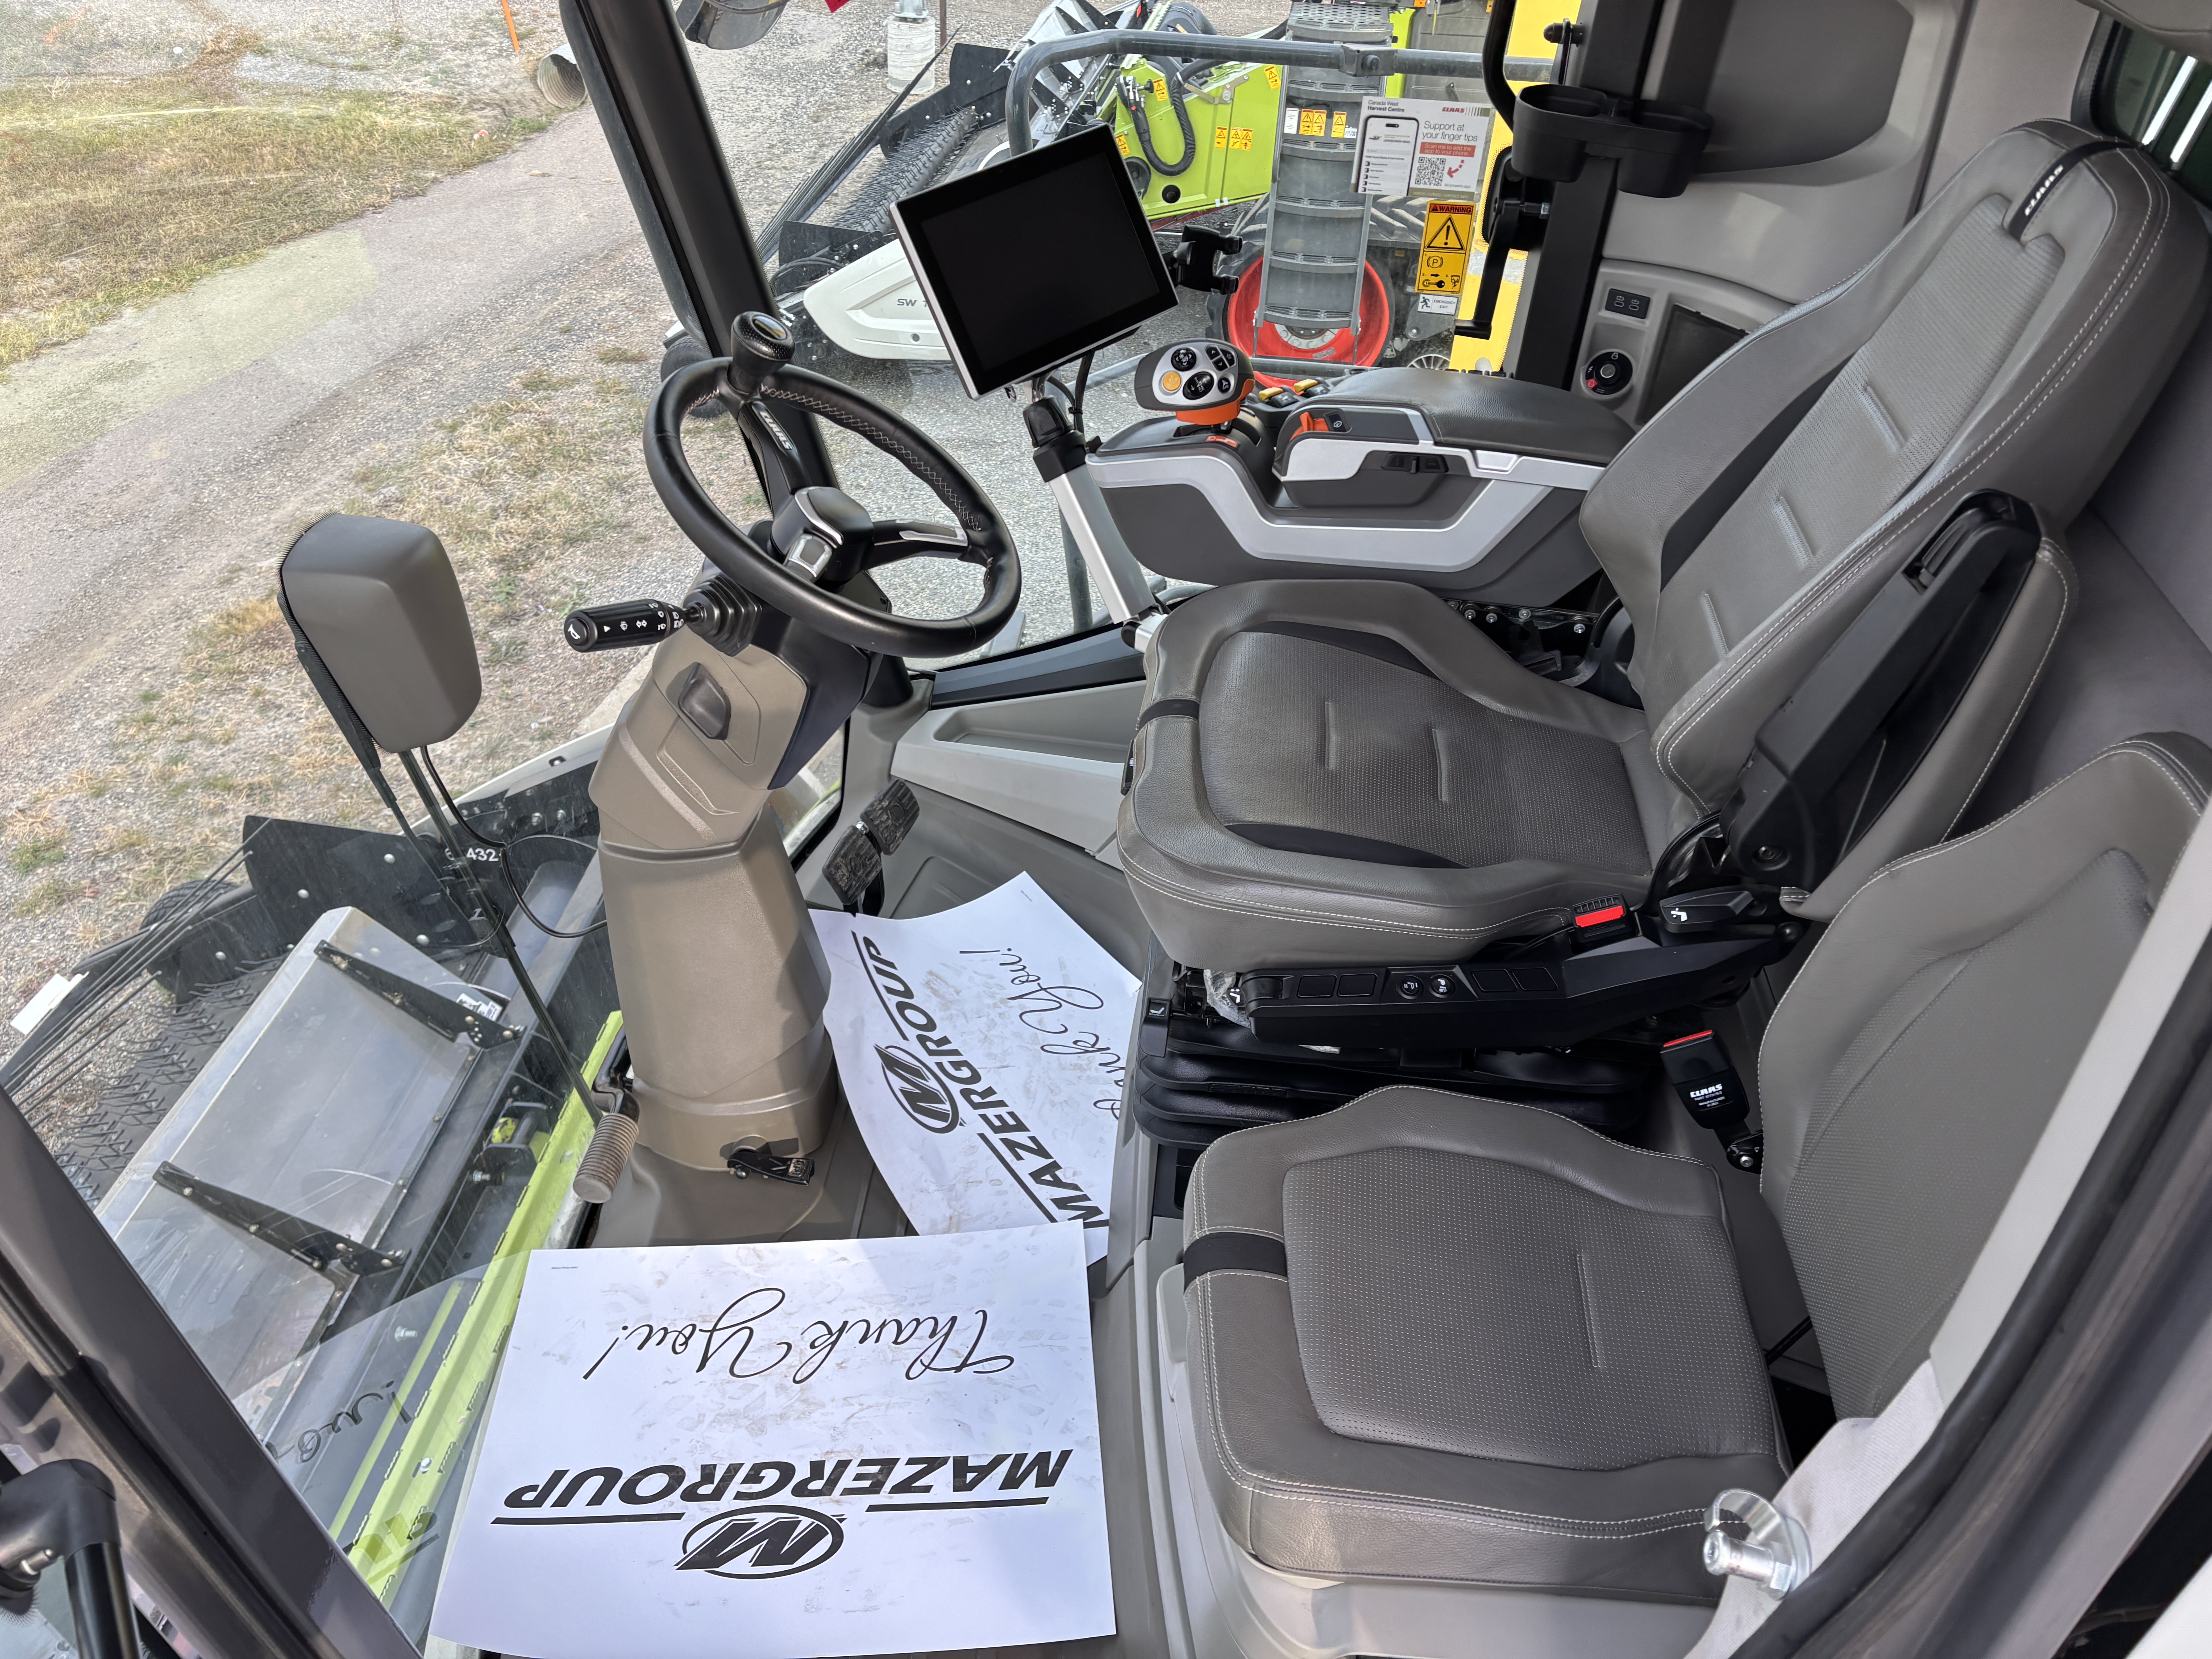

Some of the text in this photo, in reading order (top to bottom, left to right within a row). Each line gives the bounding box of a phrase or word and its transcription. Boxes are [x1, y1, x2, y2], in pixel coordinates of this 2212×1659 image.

[1422, 132, 1478, 143] your finger tips
[1424, 120, 1455, 131] Support
[2024, 164, 2064, 216] CLAAS
[897, 299, 917, 307] SW
[759, 411, 793, 449] CLAAS
[959, 947, 1104, 1034] You!
[863, 936, 1109, 1230] MAZERGROUP
[1690, 1084, 1723, 1098] CLAAS
[582, 1288, 1015, 1384] Thank You!
[504, 1449, 1074, 1508] MAZERGROUP
